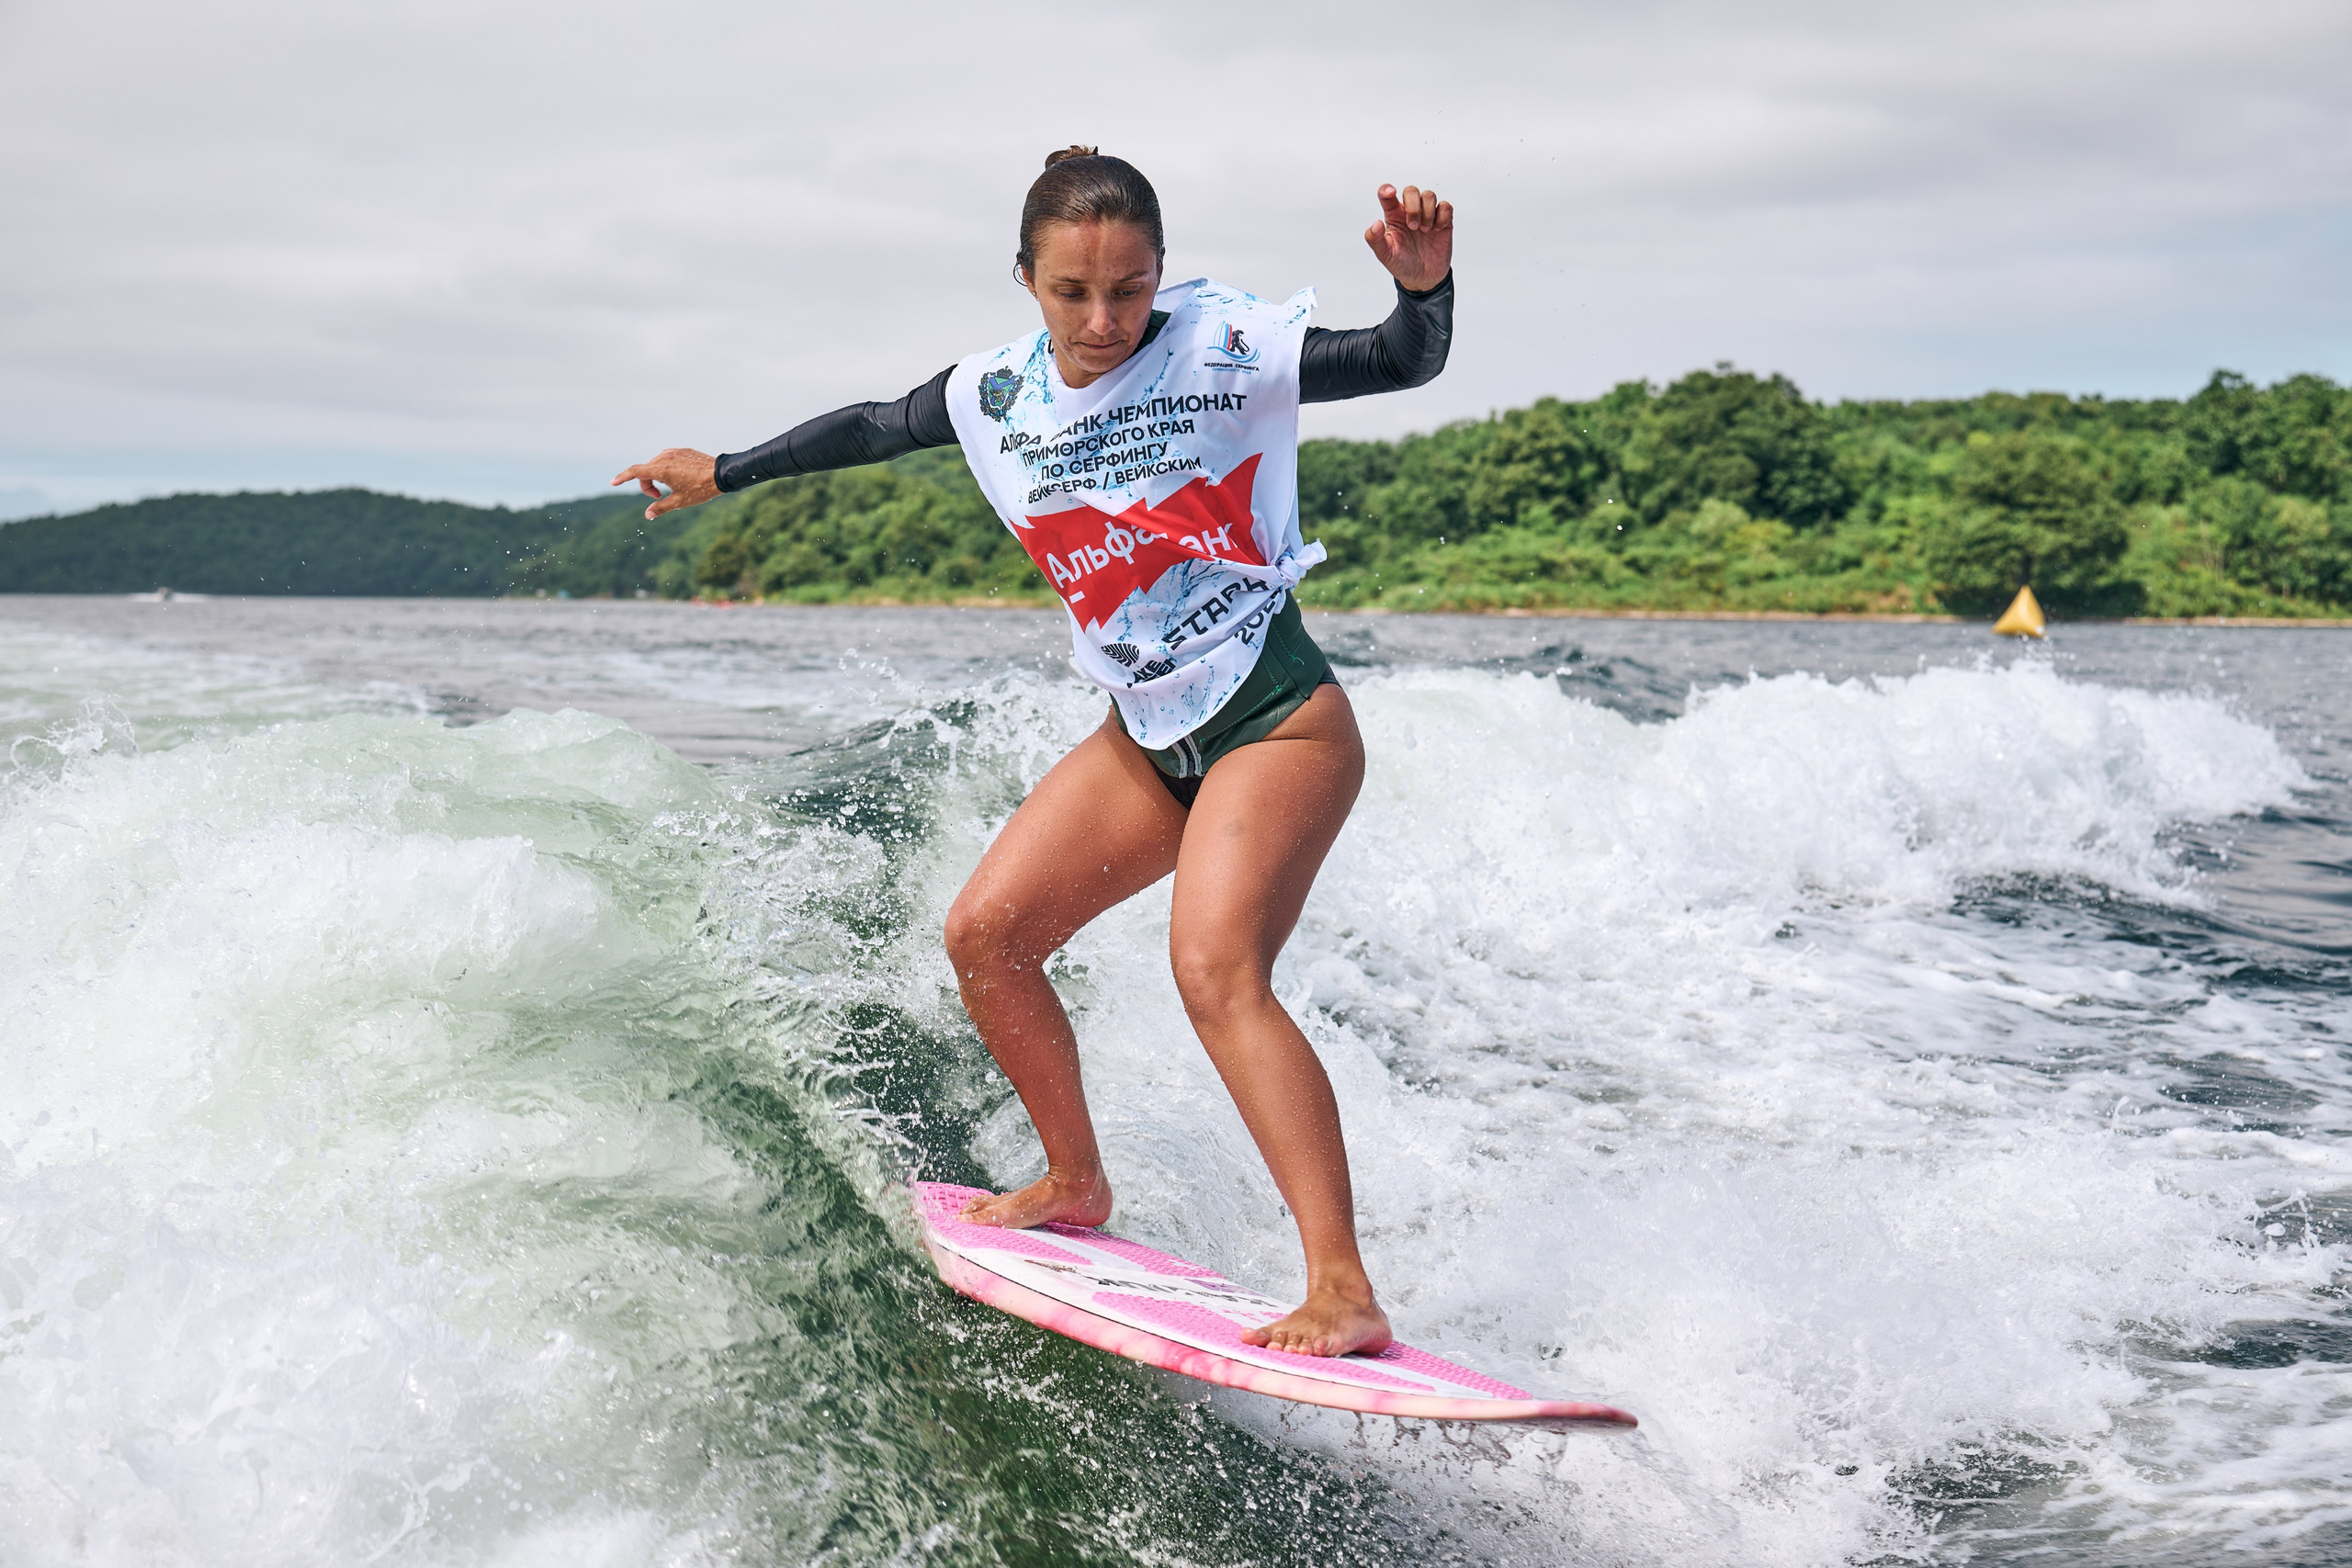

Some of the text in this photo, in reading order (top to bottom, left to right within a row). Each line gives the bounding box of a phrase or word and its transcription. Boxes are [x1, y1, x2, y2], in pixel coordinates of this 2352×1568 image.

[1000, 392, 1248, 454] АЛФА АНК ЧЕМПИОНАТ
[1022, 419, 1195, 468] ПРИМОРСКОГО КРАЯ
[1041, 441, 1169, 480] ПО СЕРФИНГУ
[1114, 456, 1203, 486] ВЕЙКСКИМ
[1046, 521, 1169, 589] Альфа
